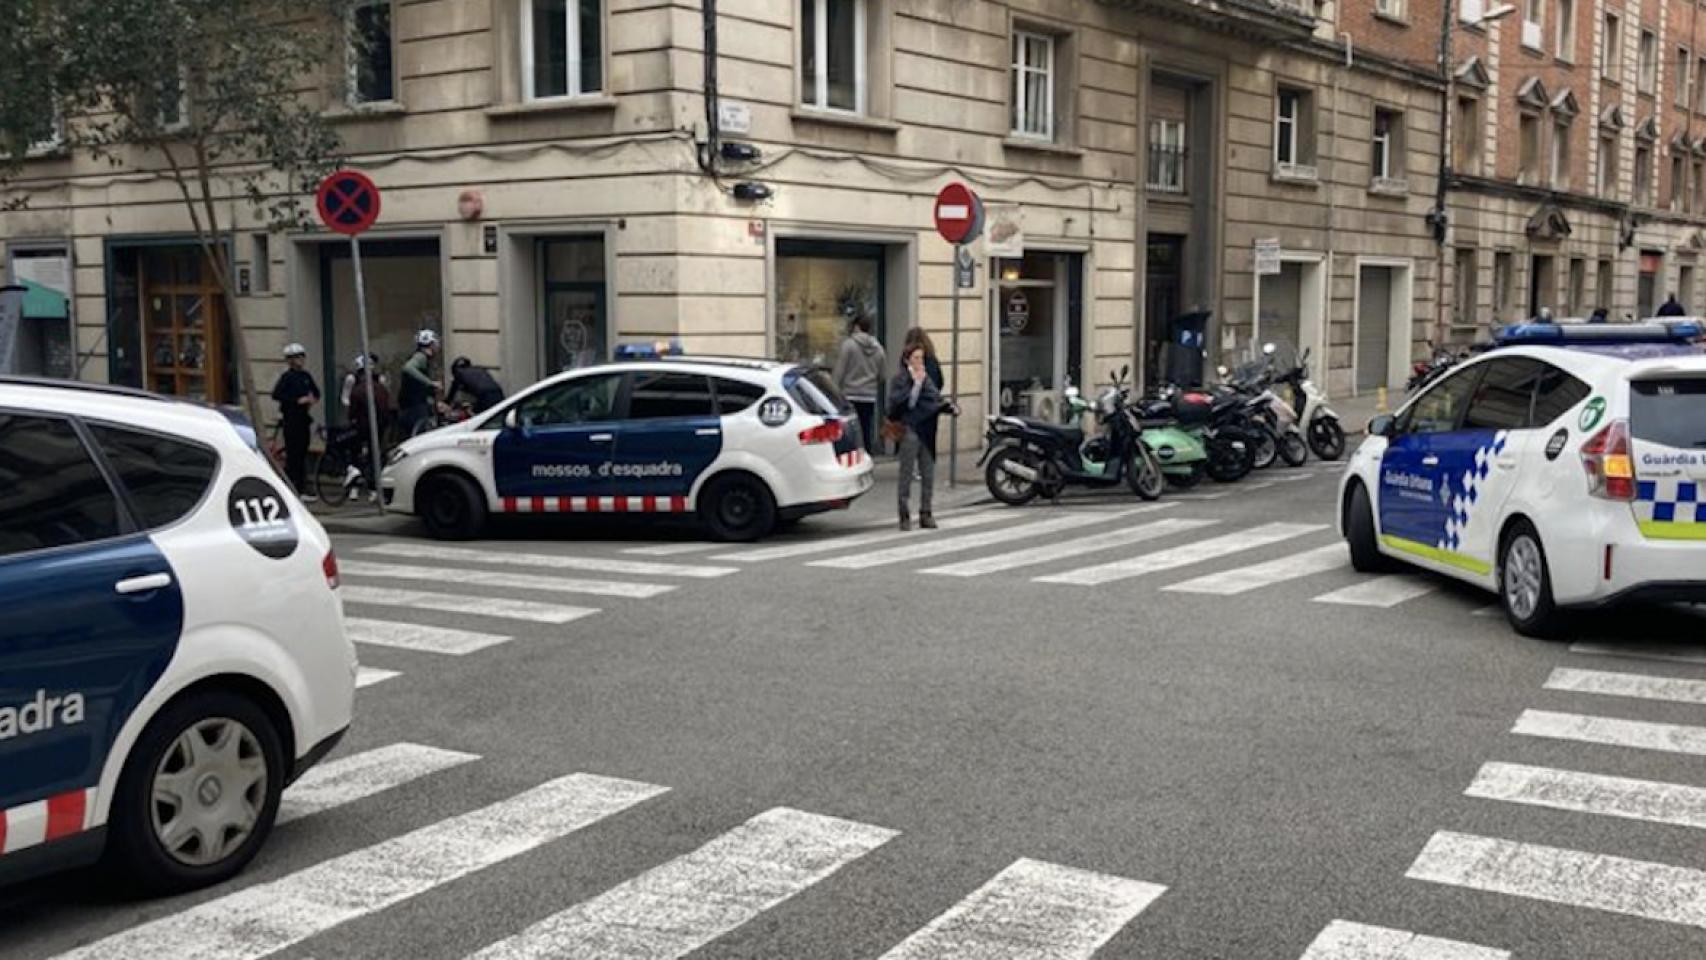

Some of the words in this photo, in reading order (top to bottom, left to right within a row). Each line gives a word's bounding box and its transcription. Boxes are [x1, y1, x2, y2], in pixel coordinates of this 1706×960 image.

[531, 463, 591, 477] mossos
[598, 460, 683, 479] d'esquadra
[235, 495, 286, 529] 112
